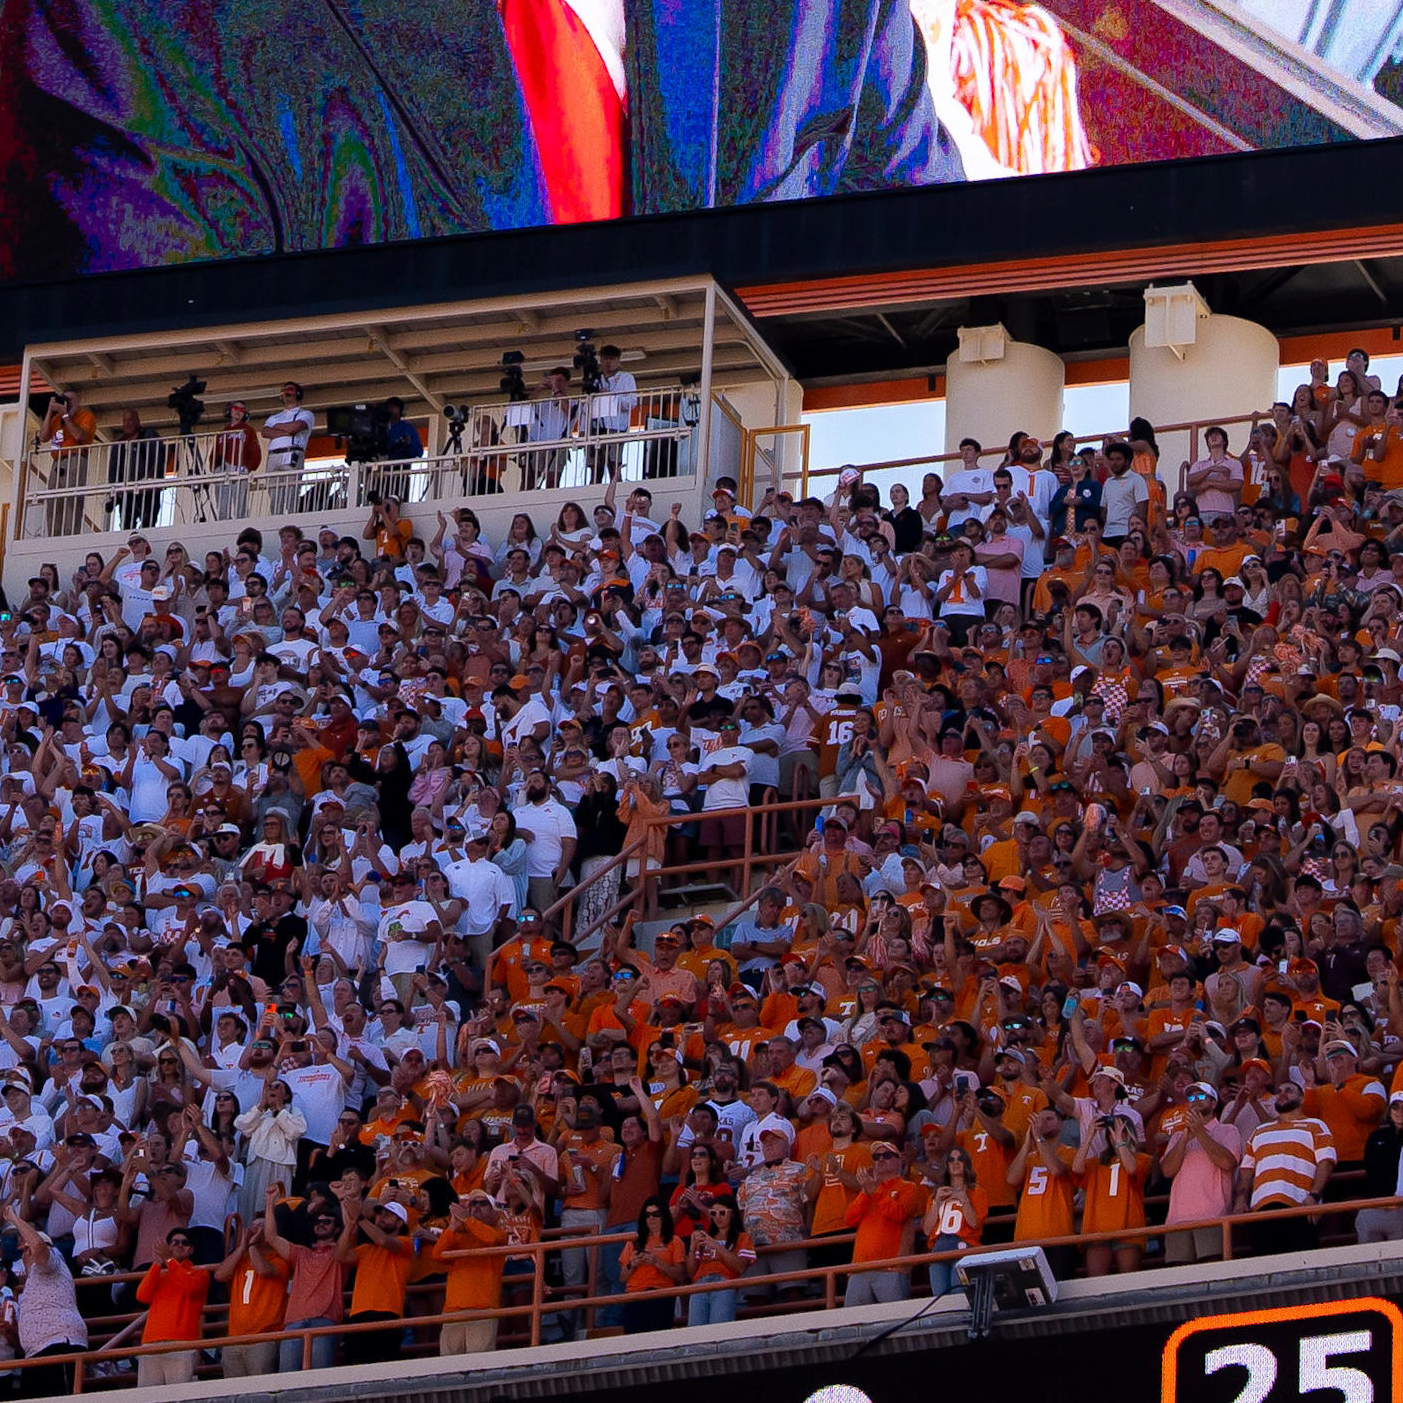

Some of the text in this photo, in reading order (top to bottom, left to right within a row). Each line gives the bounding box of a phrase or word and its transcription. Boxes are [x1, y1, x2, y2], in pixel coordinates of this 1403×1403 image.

[826, 721, 853, 744] 16
[839, 1002, 856, 1016] T
[1314, 1004, 1325, 1012] T
[1021, 1095, 1032, 1106] T
[1124, 1085, 1144, 1096] XAS
[973, 1132, 989, 1153] T
[1027, 1166, 1048, 1196] 5
[1108, 1164, 1120, 1196] 1
[243, 1270, 254, 1304] 1
[1204, 1330, 1376, 1403] 25
